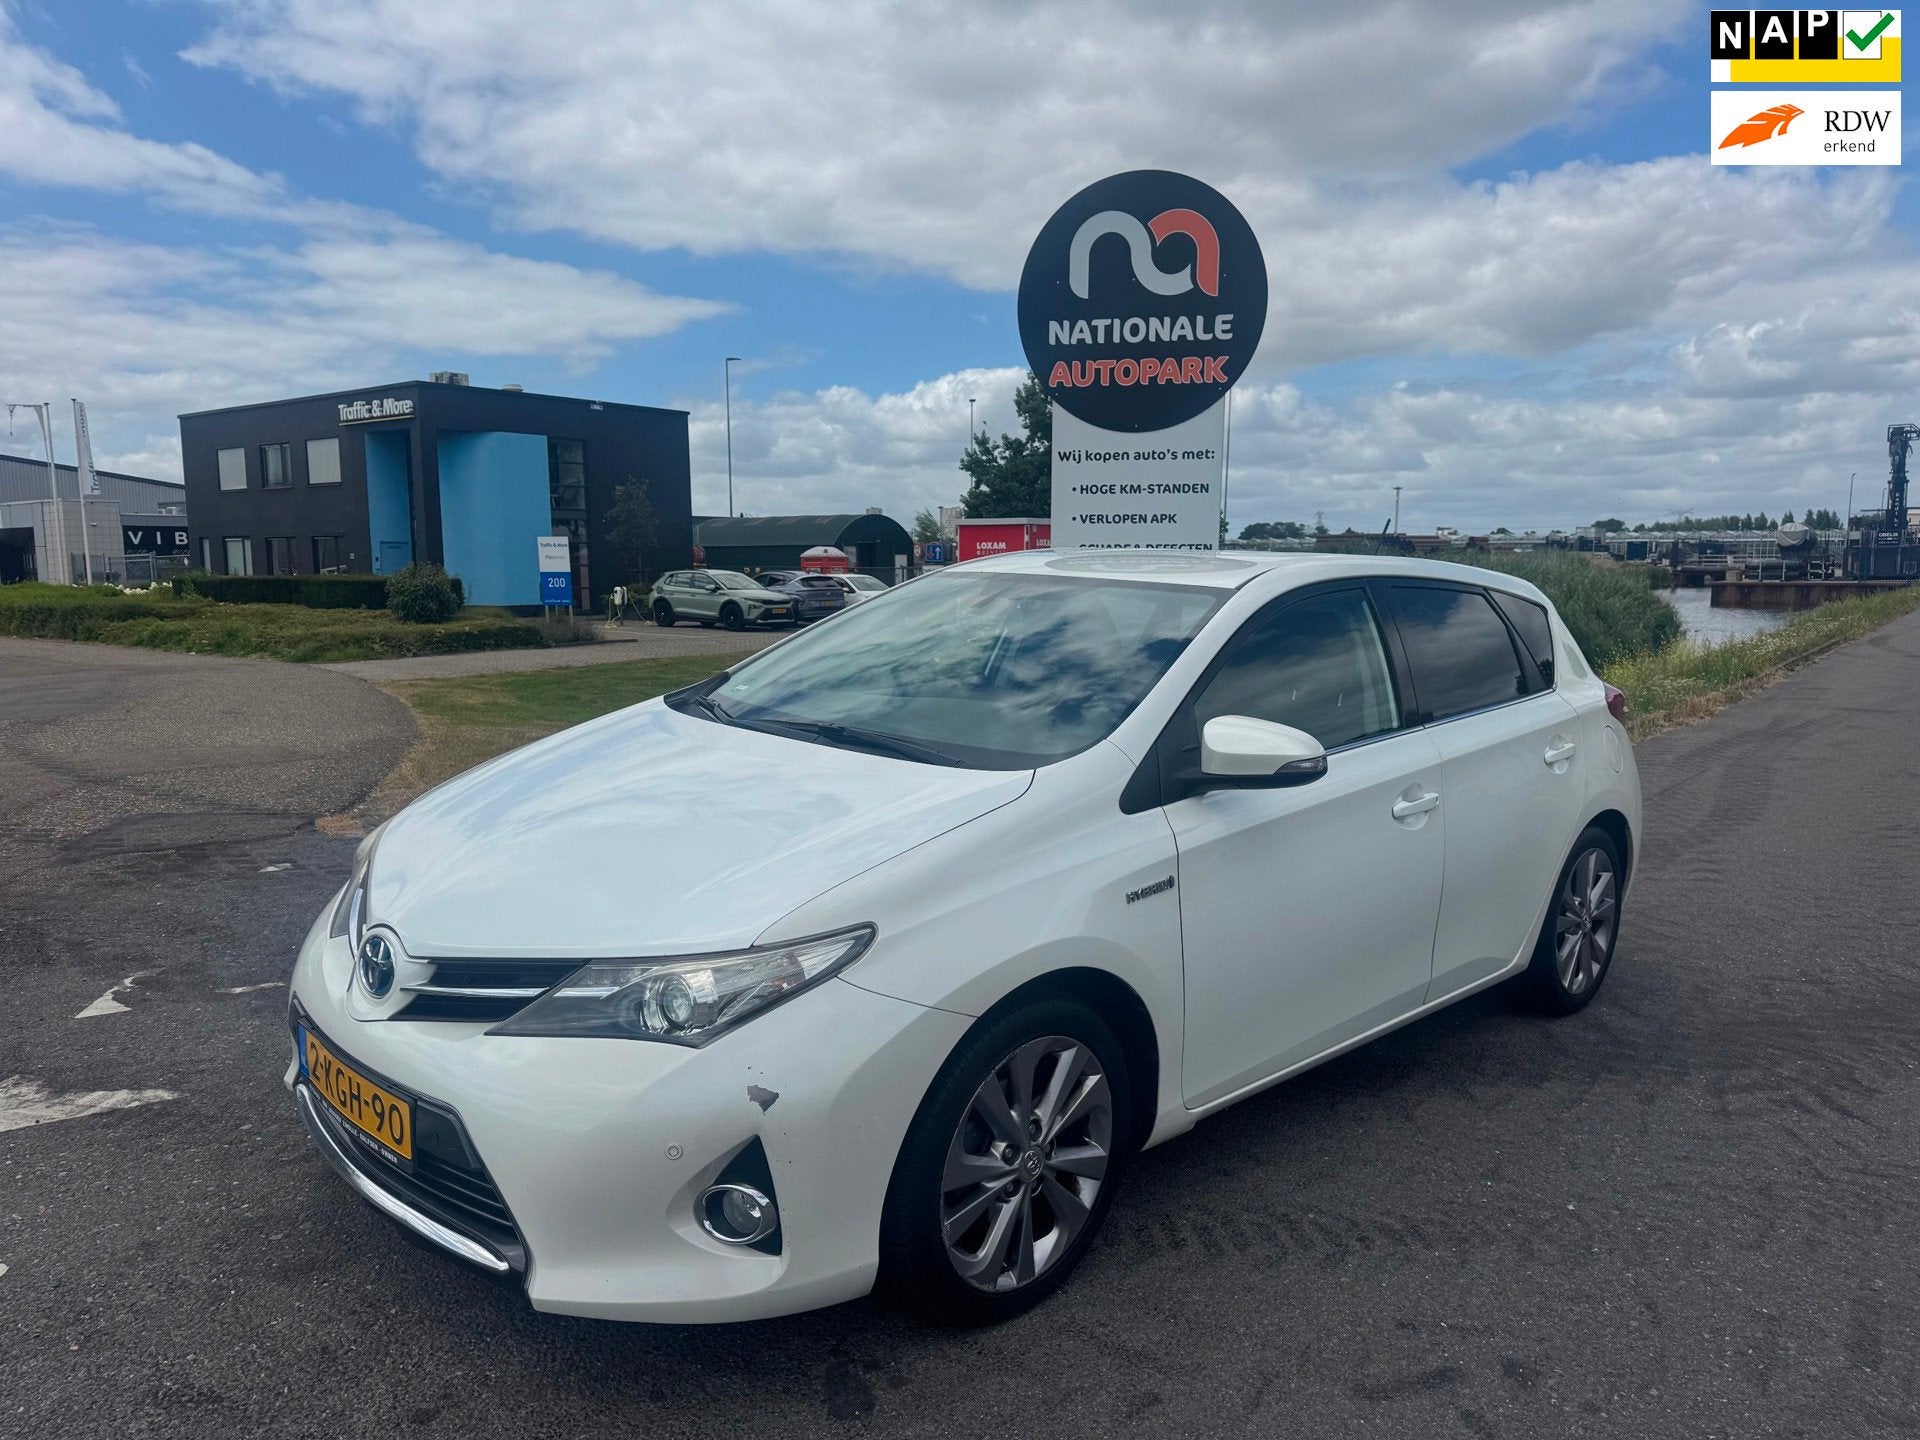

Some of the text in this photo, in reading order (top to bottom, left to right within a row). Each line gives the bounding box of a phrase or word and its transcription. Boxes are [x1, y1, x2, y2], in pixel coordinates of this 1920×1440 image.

[1048, 313, 1235, 346] NATIONALE
[1048, 355, 1230, 388] AUTOPARK
[337, 398, 414, 421] Traffic & More
[1058, 448, 1215, 464] Wij kopen auto's met:
[1080, 483, 1209, 495] HOGE KM-STANDEN
[1080, 513, 1178, 524] VERLOPEN APK
[976, 541, 1006, 549] LOXAM
[548, 577, 566, 588] 200
[309, 1041, 404, 1146] 2-KGH-90
